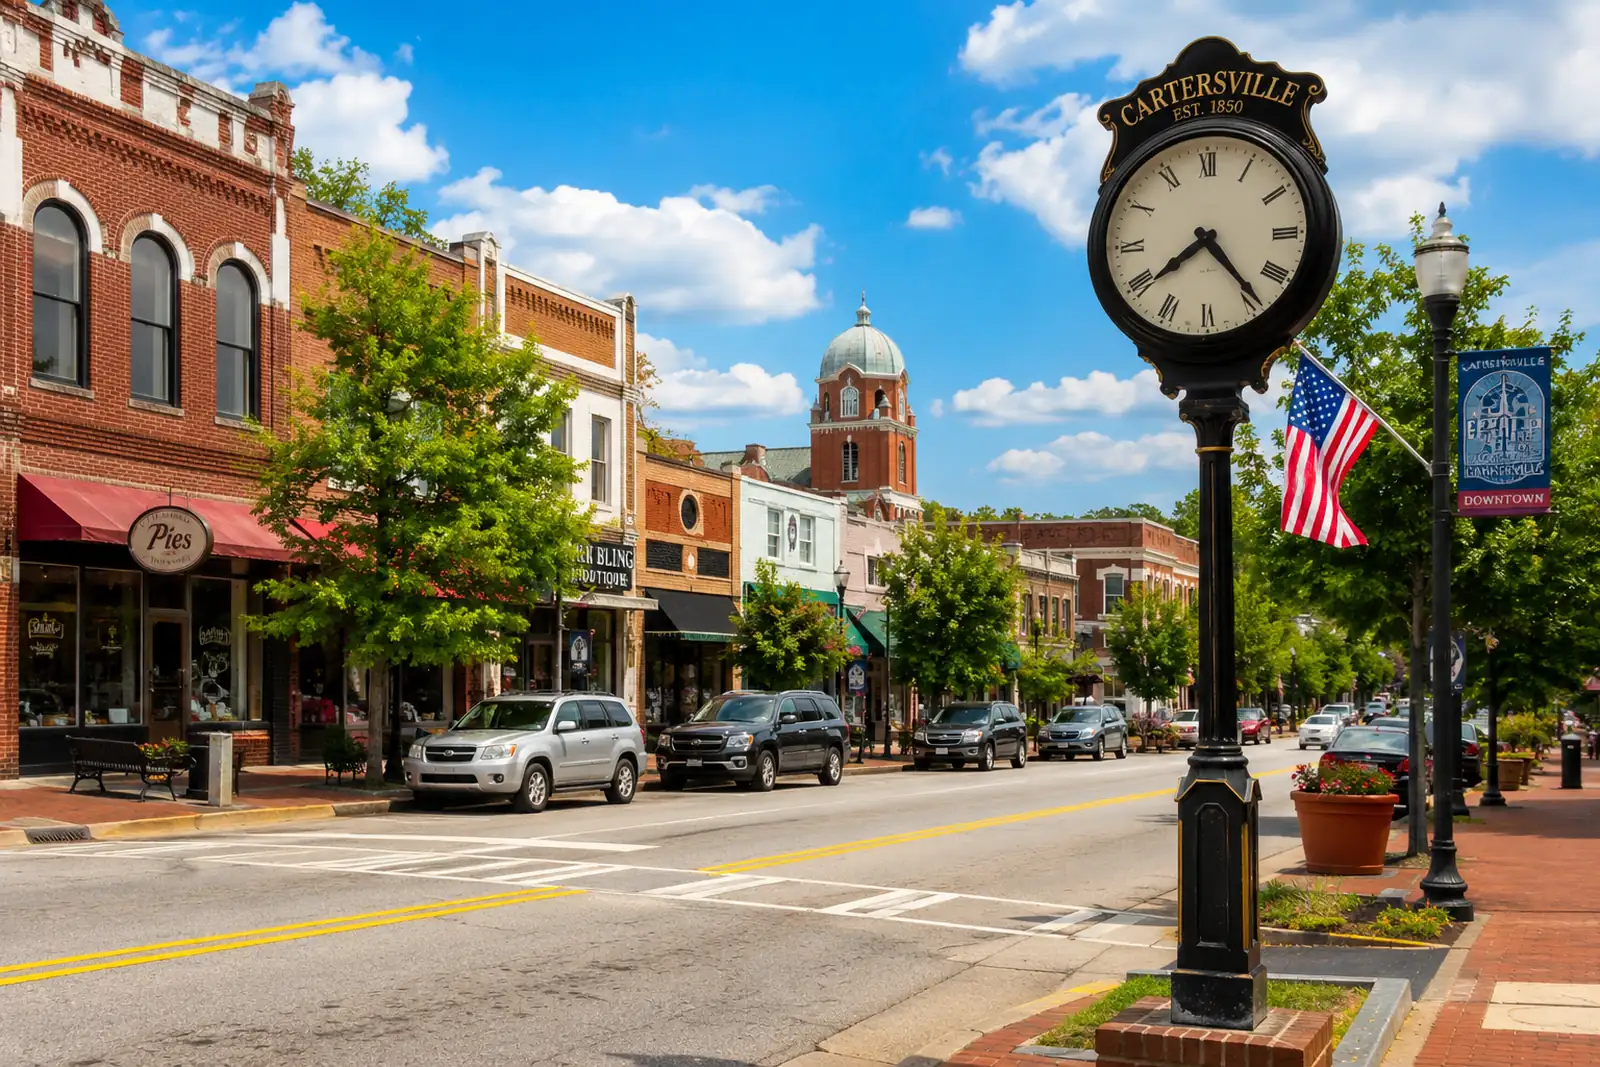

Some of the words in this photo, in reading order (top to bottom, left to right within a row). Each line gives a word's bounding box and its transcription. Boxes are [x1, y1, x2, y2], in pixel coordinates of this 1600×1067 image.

[1120, 70, 1300, 127] CARTERSVILLE
[1172, 103, 1204, 122] EST.
[1210, 100, 1244, 114] 1850
[1198, 152, 1217, 178] XII
[1238, 158, 1254, 182] I
[1158, 165, 1181, 192] XI
[1261, 184, 1287, 206] II
[1129, 199, 1155, 217] X
[1120, 238, 1145, 254] IX
[1272, 226, 1298, 241] III
[1128, 268, 1156, 298] VIII
[1260, 259, 1289, 285] IIII
[1157, 293, 1180, 322] VII
[1200, 303, 1215, 328] VI
[1464, 493, 1545, 506] DOWNTOWN
[146, 523, 192, 550] Pies
